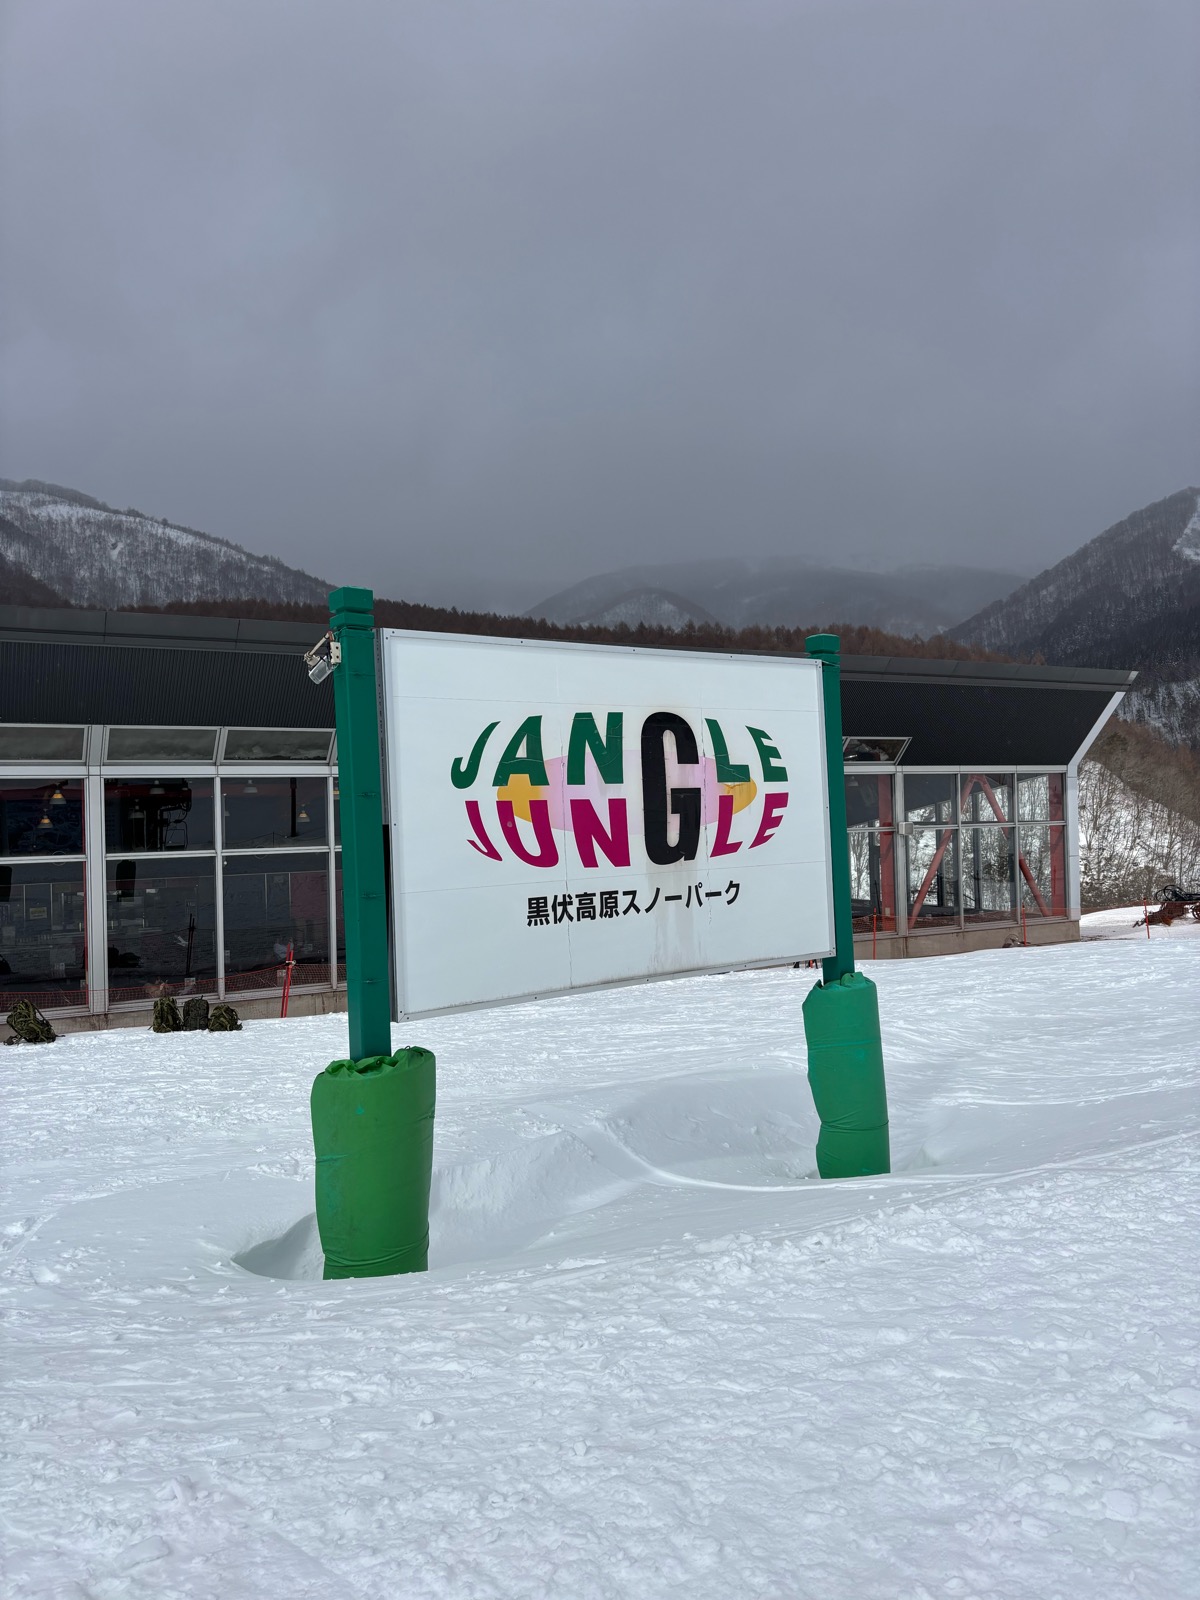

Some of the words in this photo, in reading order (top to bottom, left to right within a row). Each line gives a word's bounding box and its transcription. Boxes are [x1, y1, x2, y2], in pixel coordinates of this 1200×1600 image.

[450, 711, 789, 790] JANGLE
[464, 786, 790, 868] JUNGLE
[526, 880, 741, 928] 黒伏高原スノーパーク
